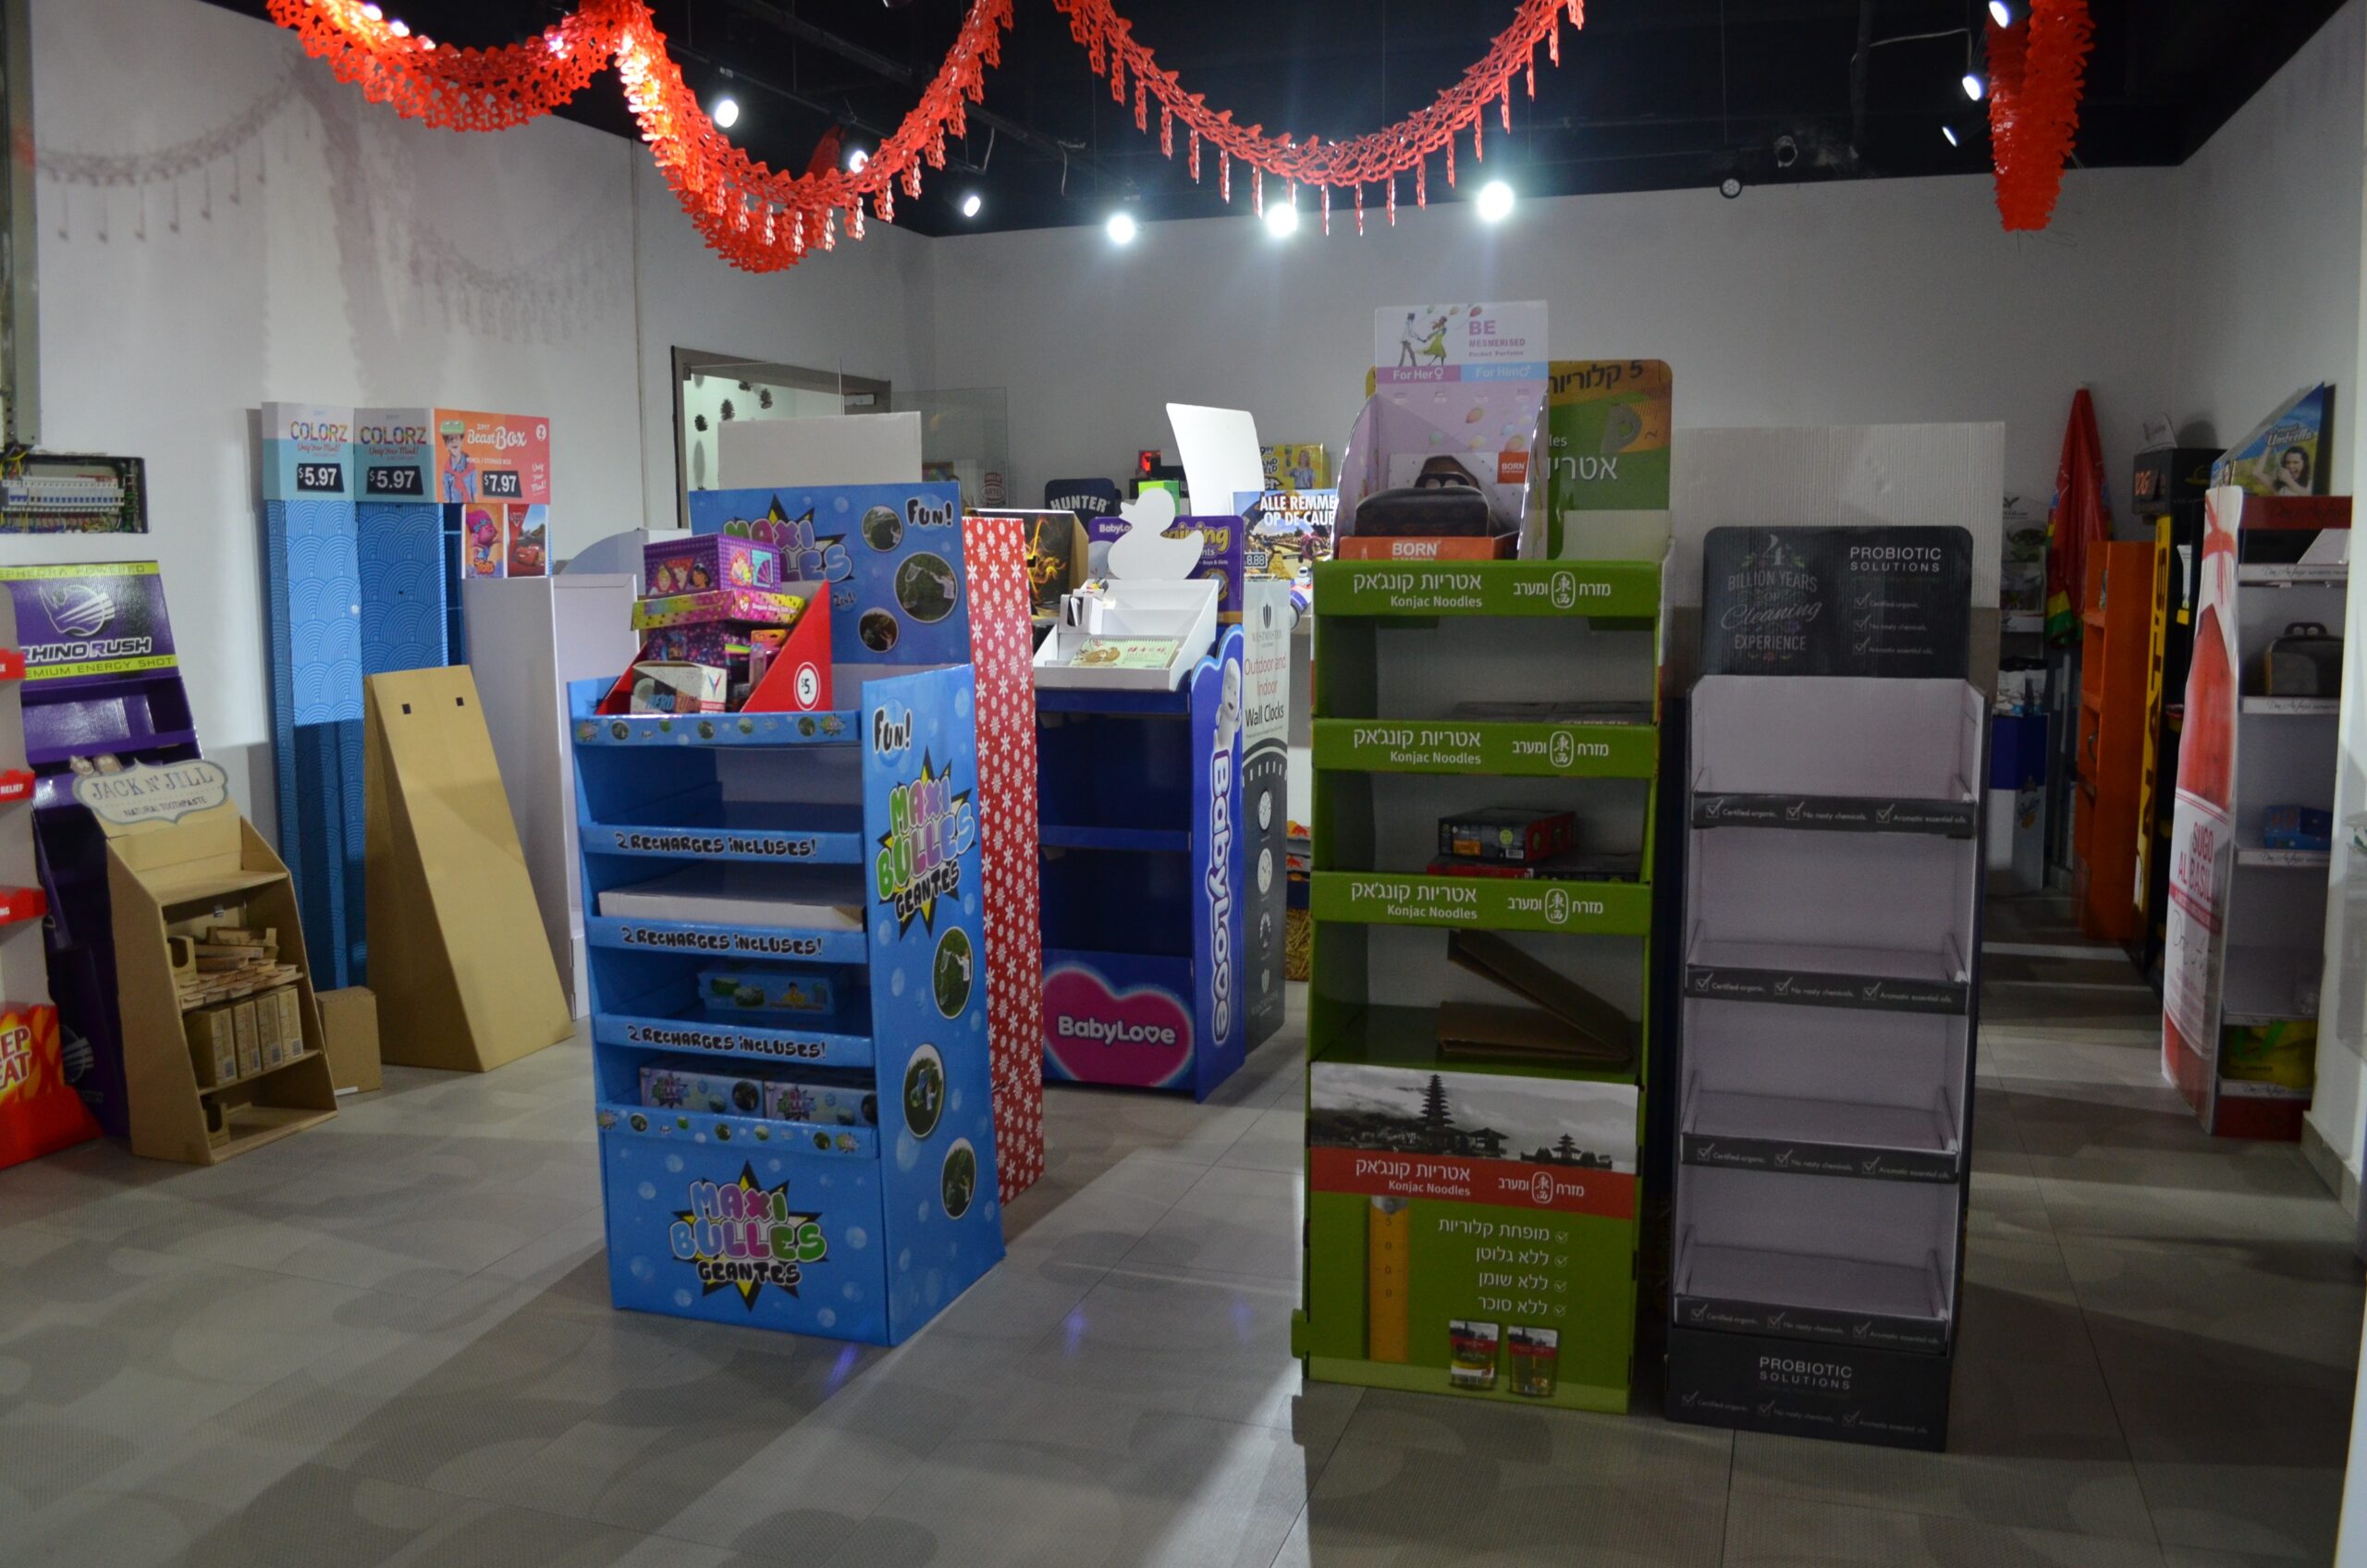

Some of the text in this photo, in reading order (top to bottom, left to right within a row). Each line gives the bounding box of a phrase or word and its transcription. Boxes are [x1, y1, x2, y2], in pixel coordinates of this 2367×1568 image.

[1469, 321, 1496, 336] BE
[1469, 339, 1526, 348] MESMERISED
[1393, 371, 1432, 380] For Her
[1476, 369, 1495, 378] For
[1630, 361, 1643, 379] 5
[290, 421, 348, 442] COLORZ
[361, 426, 426, 445] COLORZ
[298, 467, 337, 486] $5.97
[370, 471, 415, 488] $5.97
[484, 474, 517, 492] $7.97
[1050, 495, 1108, 513] HUNTER
[1259, 496, 1287, 510] ALLE
[1264, 512, 1281, 526] OP
[1284, 512, 1300, 526] DE
[1392, 543, 1437, 556] BORN
[1762, 533, 1784, 565] 4
[1850, 546, 1942, 560] PROBIOTIC
[1850, 562, 1940, 572] SOLUTIONS
[1421, 574, 1481, 590] אטריות
[1514, 582, 1612, 596] מזרח ומערב
[1728, 570, 1818, 593] BILLION YEARS
[1391, 595, 1482, 609] Konjac Noodles
[1721, 602, 1822, 630] Cleaning
[89, 637, 151, 657] RUSH
[1735, 634, 1807, 651] EXPERIENCE
[78, 661, 131, 673] ENERGY
[138, 657, 174, 667] SHOT
[1245, 653, 1286, 676] Outdoor and
[1257, 680, 1278, 696] Indoor
[1245, 701, 1284, 728] Wall Clocks
[1421, 730, 1481, 748] אטריות
[1513, 741, 1609, 756] מזרח ומערב
[1390, 751, 1481, 765] Konjac Noodles
[0, 784, 24, 794] RELIEF
[92, 778, 142, 801] JACK
[166, 767, 215, 791] JILL
[124, 796, 208, 817] NATURAL TOOTHPASTE
[889, 776, 951, 836] MAXI
[616, 833, 629, 850] 2
[877, 802, 975, 900] BULLES
[2177, 851, 2188, 885] AL
[895, 859, 962, 922] GEANTES
[1417, 886, 1478, 903] אטריות
[1387, 904, 1478, 920] Konjac Noodles
[1508, 897, 1603, 914] מזרח ומערב
[621, 927, 634, 944] 2
[627, 1025, 640, 1041] 2
[1416, 1164, 1471, 1182] אטריות
[1388, 1180, 1471, 1196] Konjac Noodles
[1498, 1178, 1585, 1196] מזרח ומערב
[690, 1181, 788, 1223] MAXI
[1439, 1219, 1493, 1238] קלוריות
[670, 1218, 828, 1262] BULLES
[1477, 1246, 1549, 1266] ללא גלוטן
[697, 1261, 802, 1285] GEANTES
[1479, 1272, 1548, 1290] ללא שומן
[1478, 1296, 1548, 1315] ללא סוכר
[1759, 1356, 1853, 1378] PROBIOTIC
[1760, 1370, 1850, 1390] SOLUTIONS
